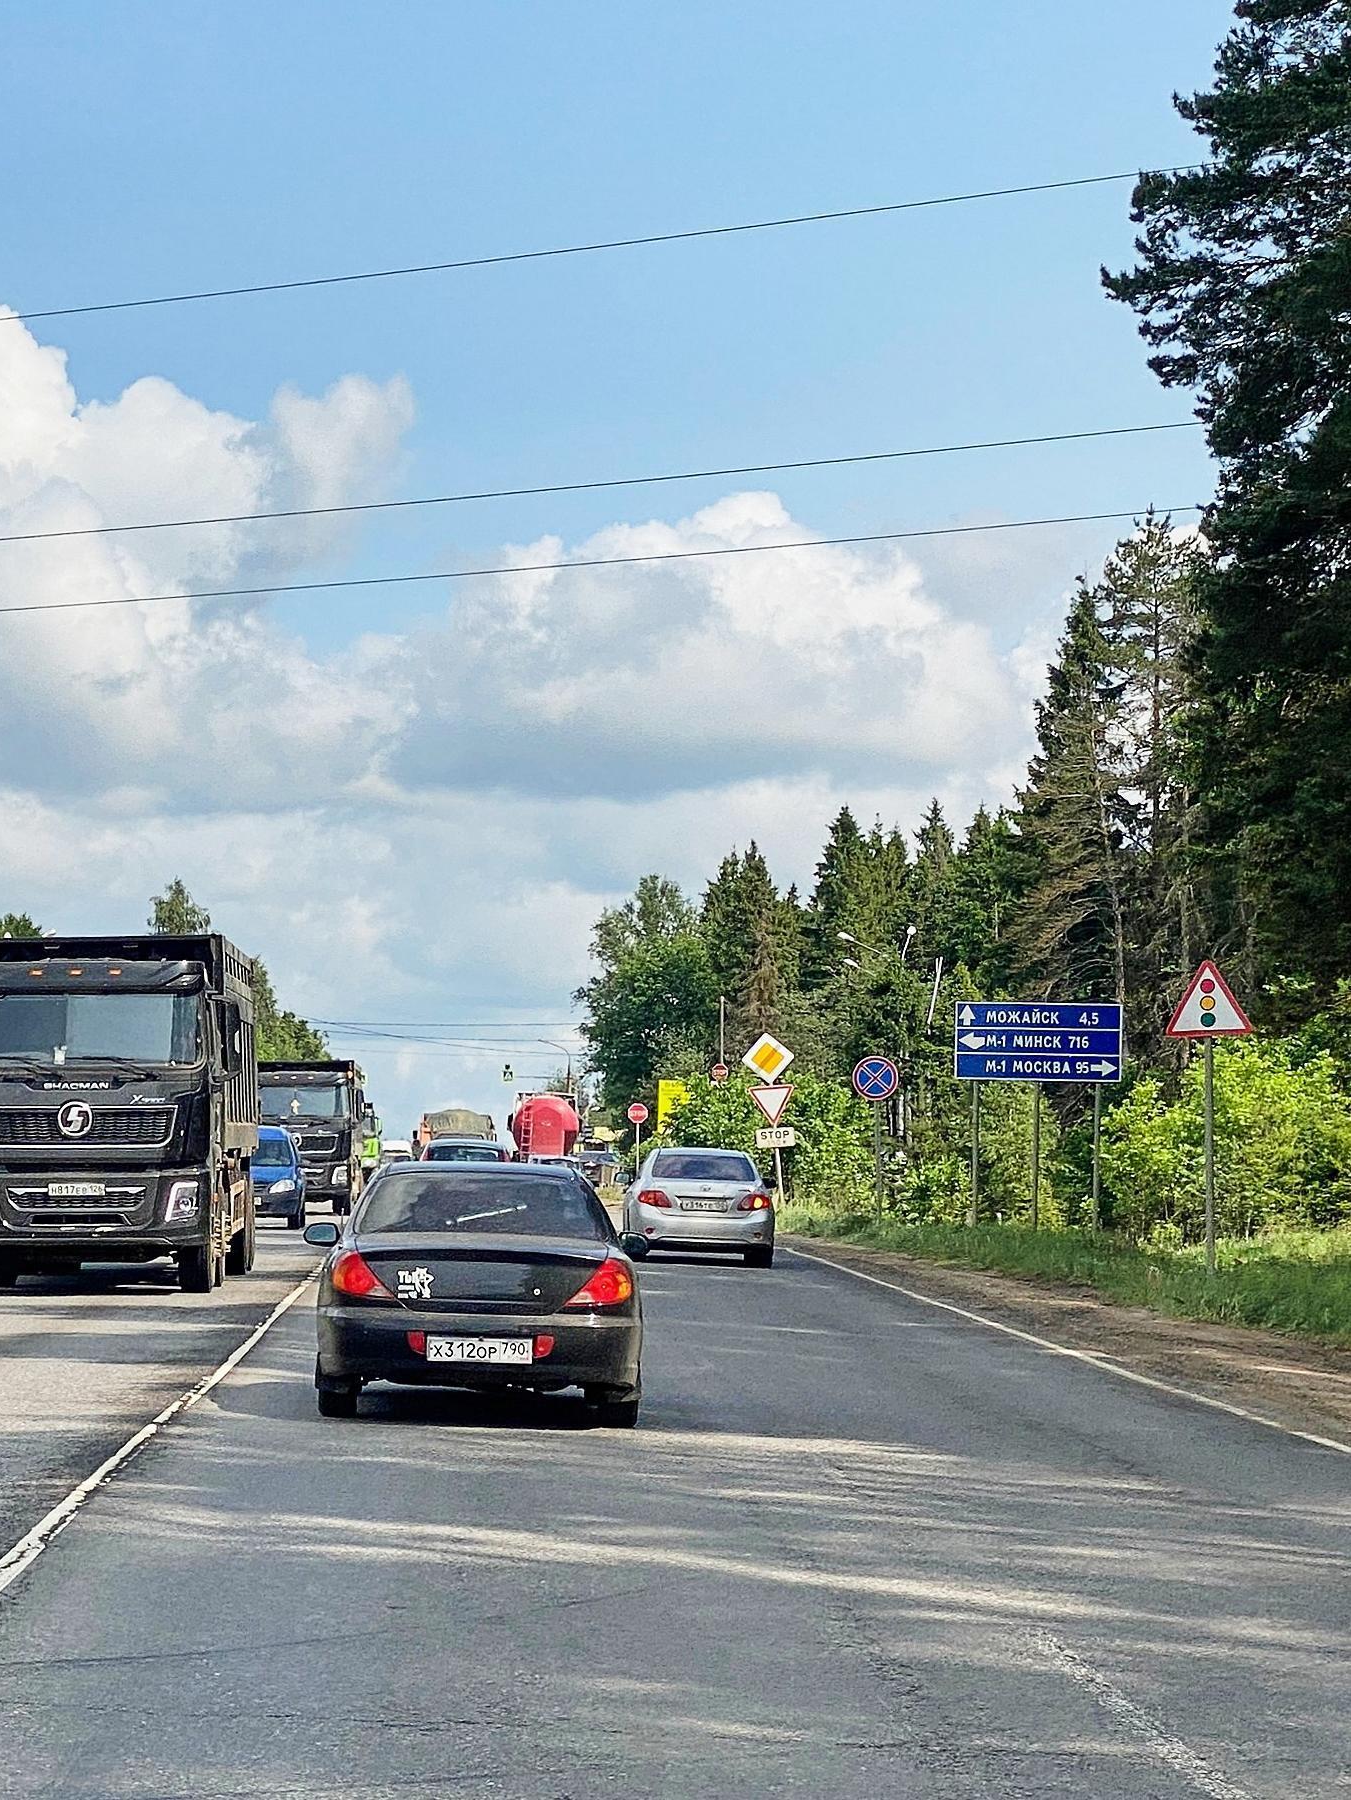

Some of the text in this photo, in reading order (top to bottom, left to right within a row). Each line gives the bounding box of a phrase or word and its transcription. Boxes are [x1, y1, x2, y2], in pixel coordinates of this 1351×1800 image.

[986, 1008, 1099, 1026] МОЖАЙСК 4,5
[986, 1034, 1090, 1049] М-1 МИНСК 716
[985, 1060, 1090, 1074] М-1 МОСКВА 95
[43, 1082, 110, 1090] SHACMAN
[760, 1130, 790, 1140] STOP
[433, 1341, 526, 1359] Х312ОР 790
